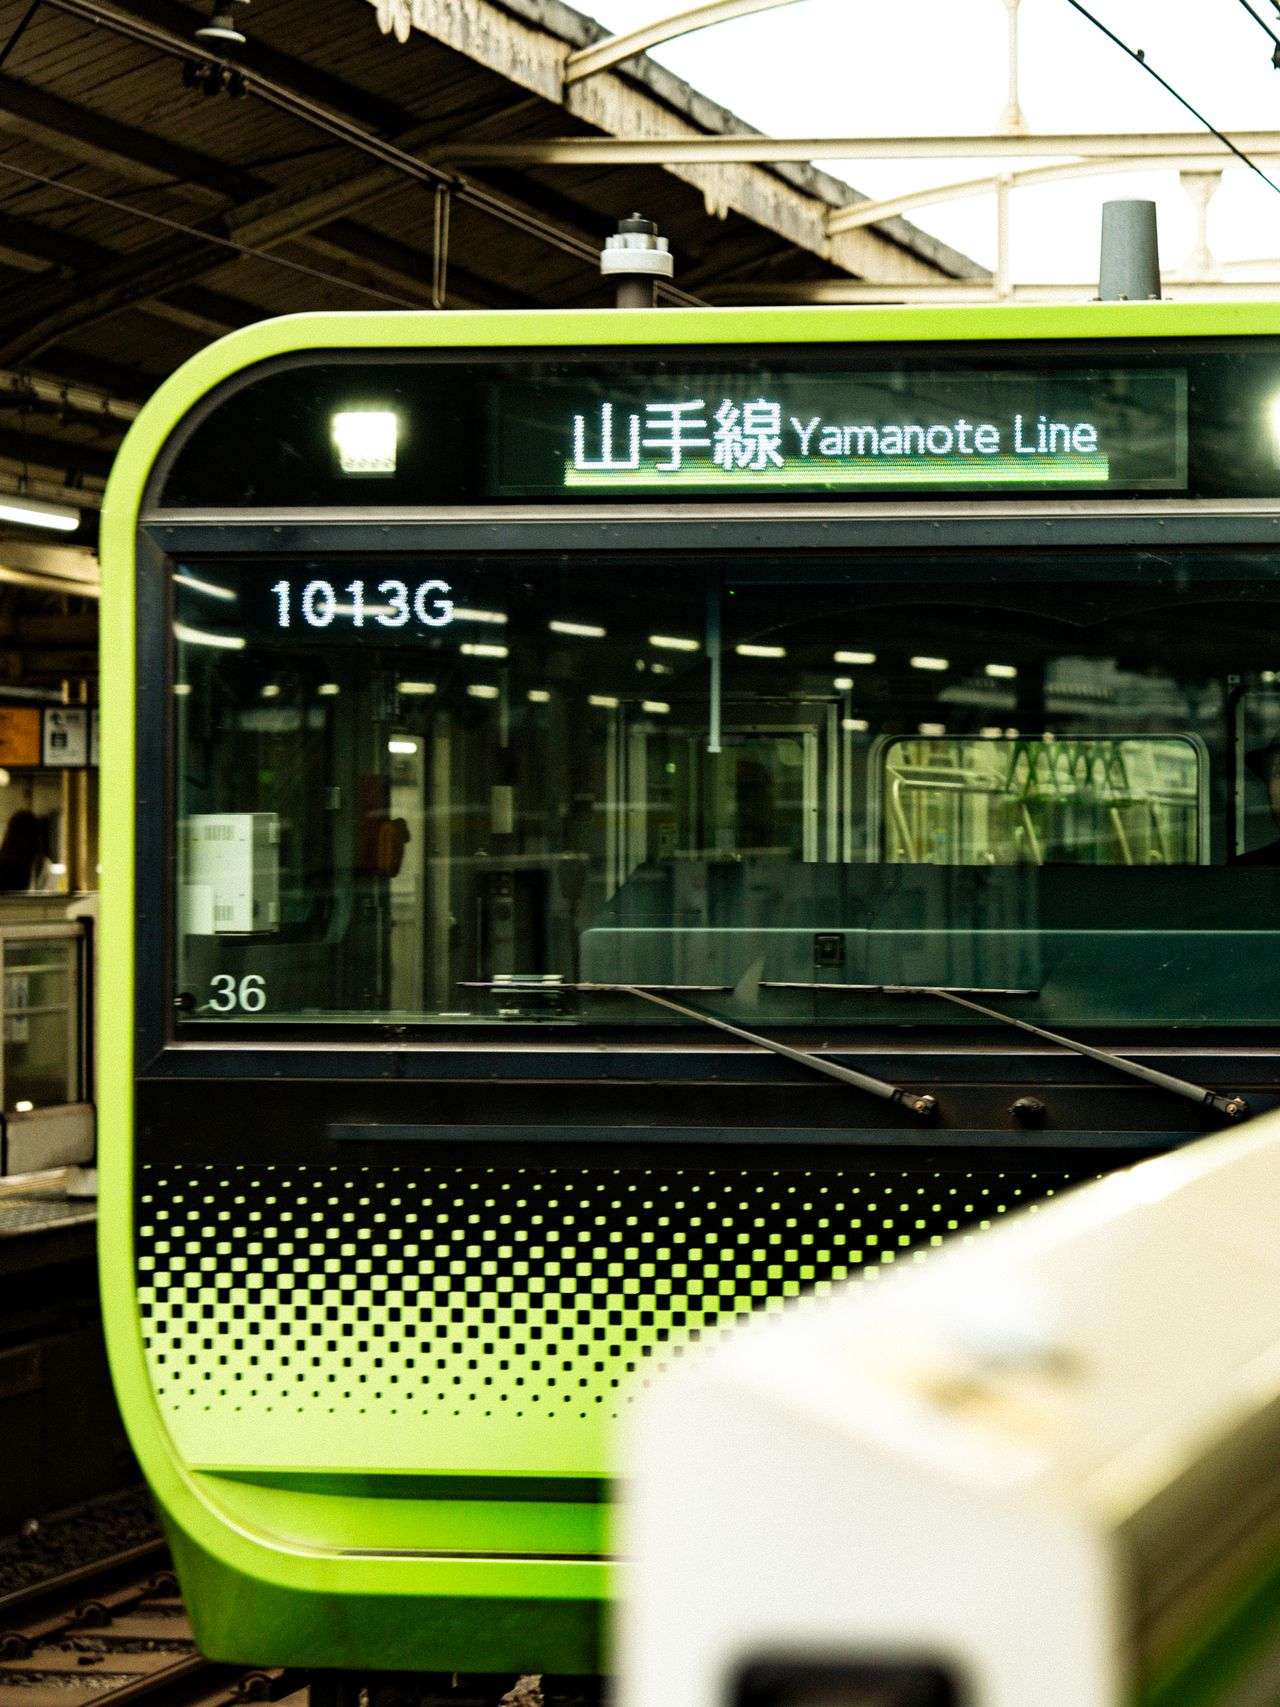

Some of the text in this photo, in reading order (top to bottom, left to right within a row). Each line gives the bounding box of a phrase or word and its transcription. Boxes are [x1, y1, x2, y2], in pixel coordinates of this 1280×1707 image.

[570, 396, 1099, 471] 山手線 Yamanote Line
[270, 580, 454, 627] 1013G
[209, 974, 267, 1012] 36
